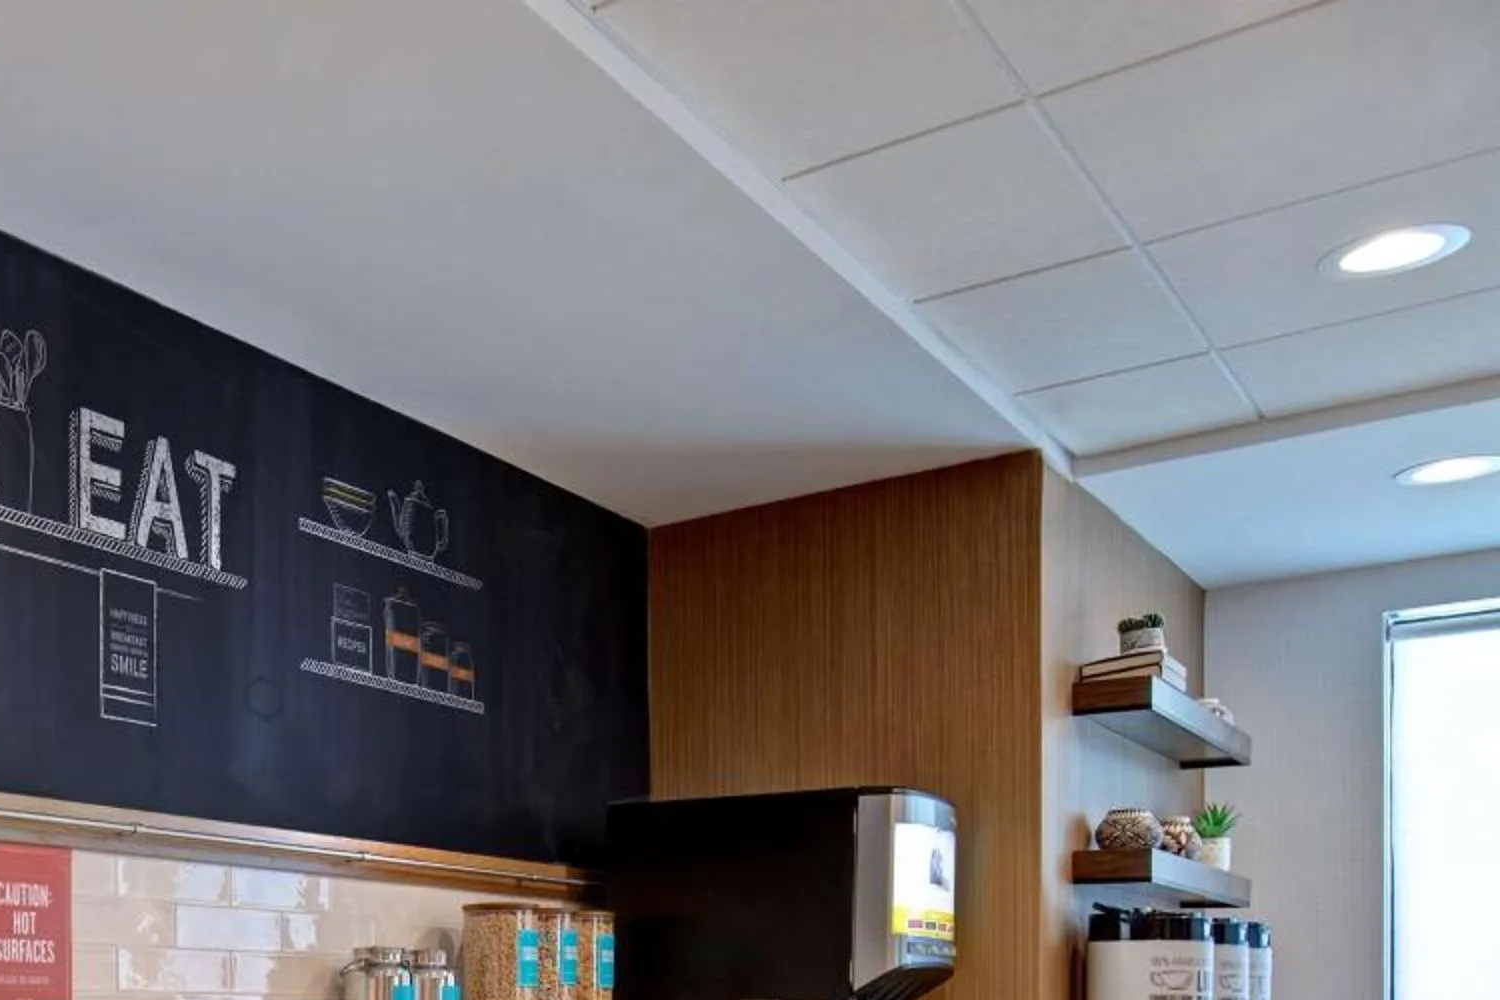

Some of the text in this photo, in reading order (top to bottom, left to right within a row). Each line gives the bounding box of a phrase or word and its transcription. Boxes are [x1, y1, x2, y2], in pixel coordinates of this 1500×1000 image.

[69, 406, 237, 571] EAT
[111, 653, 148, 679] SMILE
[13, 910, 37, 935] HOT
